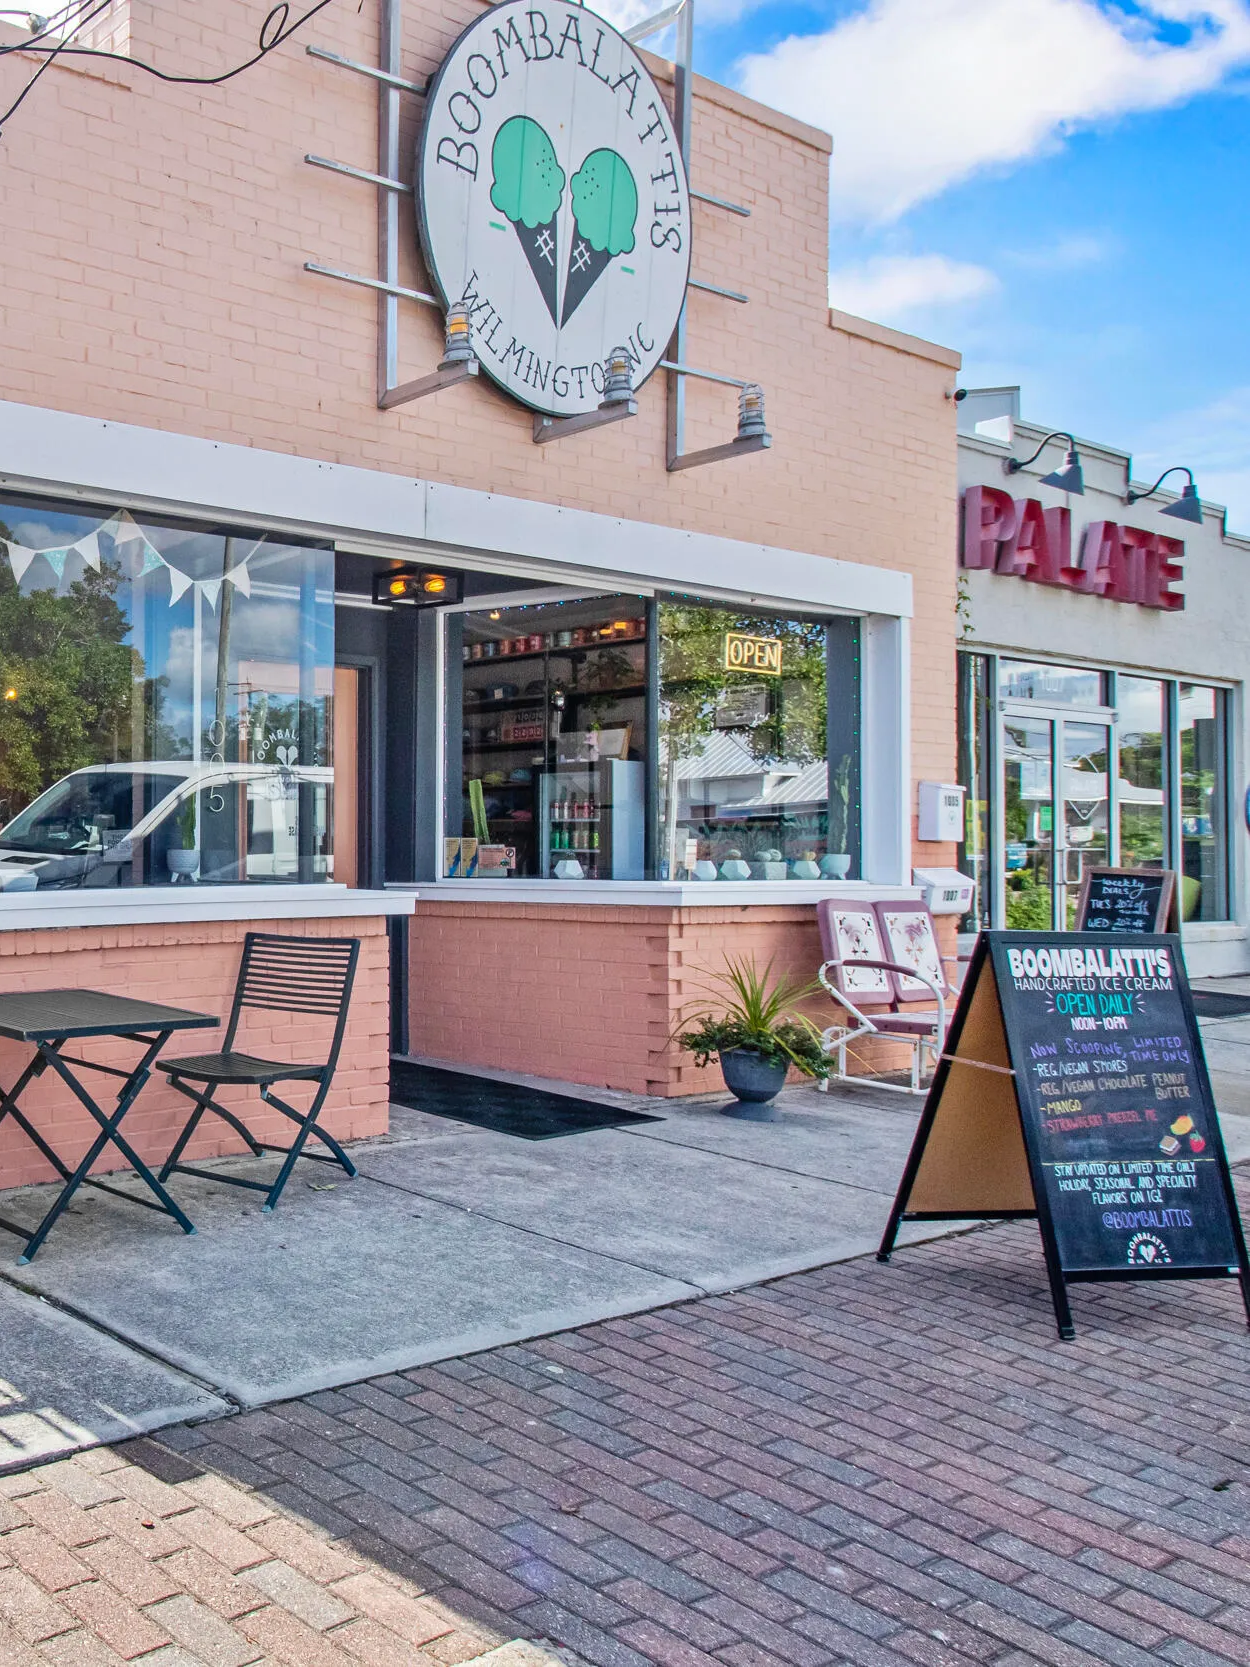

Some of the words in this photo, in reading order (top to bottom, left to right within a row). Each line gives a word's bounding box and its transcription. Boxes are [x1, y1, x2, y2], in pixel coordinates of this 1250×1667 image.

[461, 269, 608, 399] WILMINGTO
[963, 485, 1185, 611] PALATE
[730, 640, 778, 667] OPEN
[1102, 887, 1130, 895] DEALS
[1090, 899, 1111, 909] TUES
[1088, 918, 1110, 928] WED
[1007, 949, 1171, 977] BOOMBALATTI'S
[1014, 978, 1095, 991] HANDCRAFTED
[1100, 978, 1122, 990] ICE
[1125, 978, 1173, 990] CREAM
[1056, 993, 1096, 1016] OPEN
[1099, 993, 1133, 1015] DAILY
[1132, 1036, 1181, 1048] LIMITED
[1130, 1050, 1160, 1061] TIME
[1099, 1074, 1147, 1090] CHOCOLATE
[1152, 1073, 1186, 1087] PEANUT
[1155, 1086, 1190, 1100] BUTTER
[1055, 1164, 1073, 1176] STAY
[1074, 1163, 1107, 1175] UPDATED
[1108, 1164, 1121, 1175] ON
[1122, 1163, 1153, 1174] LIMITED
[1156, 1162, 1174, 1173] TIME
[1177, 1162, 1195, 1172] ONLY
[1094, 1177, 1135, 1190] SEASONAL
[1138, 1176, 1154, 1189] AND
[1155, 1175, 1197, 1188] SPECIALTY
[1092, 1192, 1128, 1205] FLAVORS
[1130, 1191, 1145, 1204] ON
